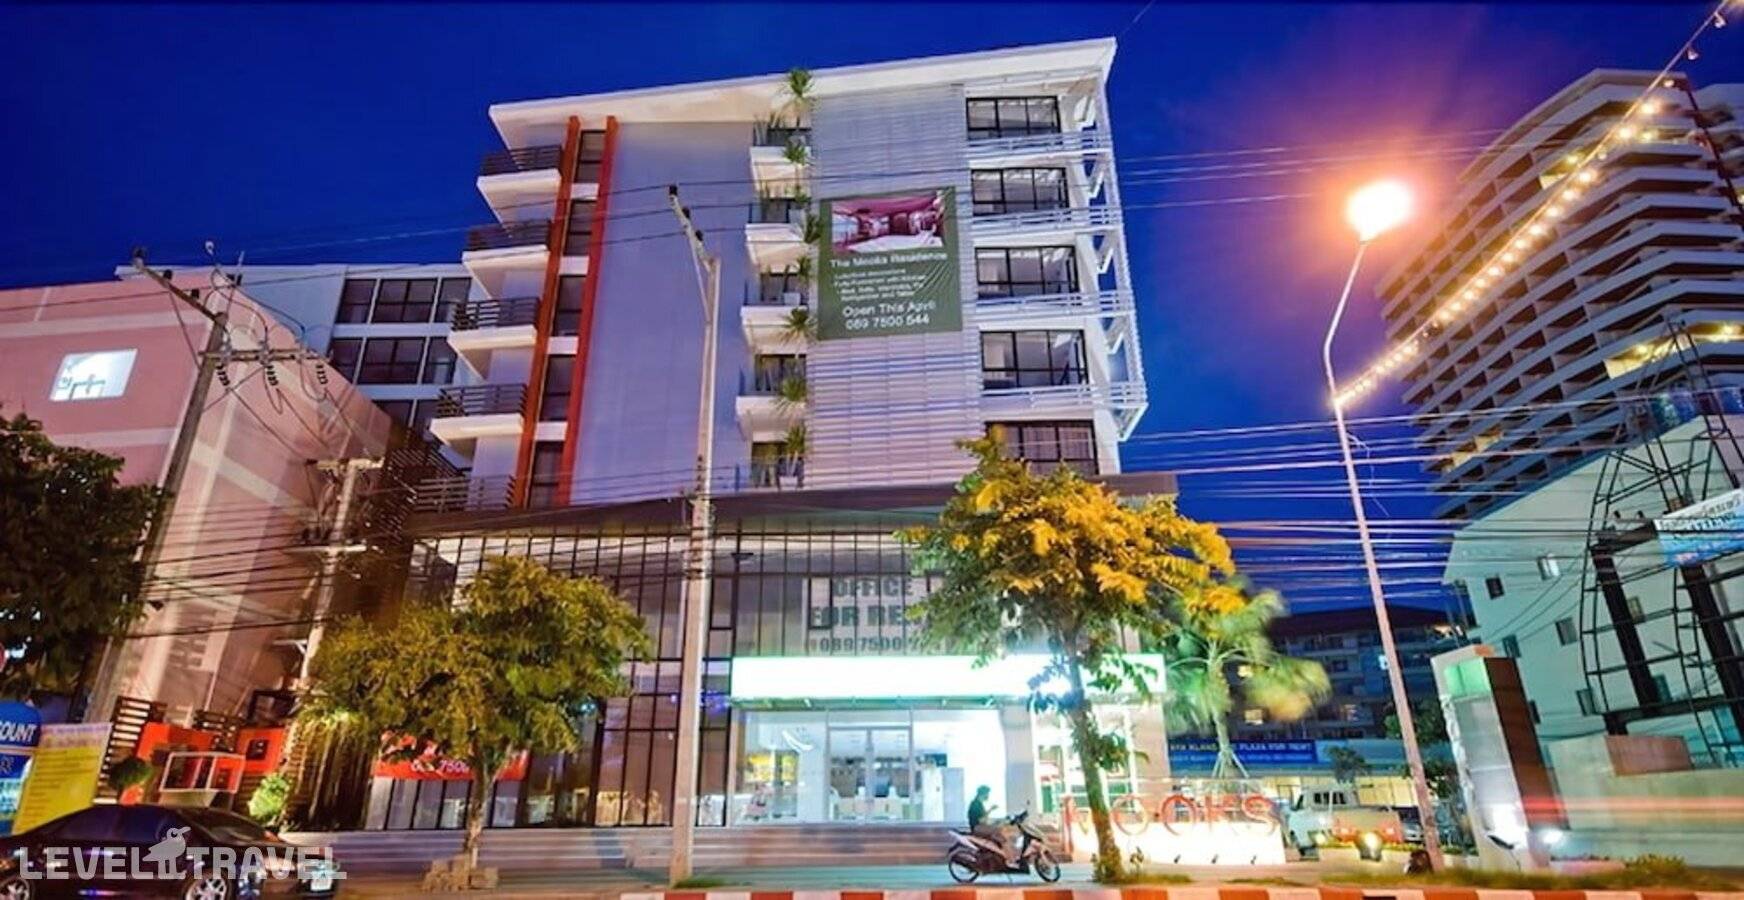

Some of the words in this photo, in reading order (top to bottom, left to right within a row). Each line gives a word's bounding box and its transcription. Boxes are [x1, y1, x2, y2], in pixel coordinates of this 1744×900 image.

[830, 259, 851, 267] The
[890, 252, 948, 263] Residence
[842, 305, 876, 317] Open
[879, 302, 904, 313] This
[872, 316, 903, 328] 7500
[832, 577, 914, 597] OFFICE
[0, 721, 37, 742] OUNT
